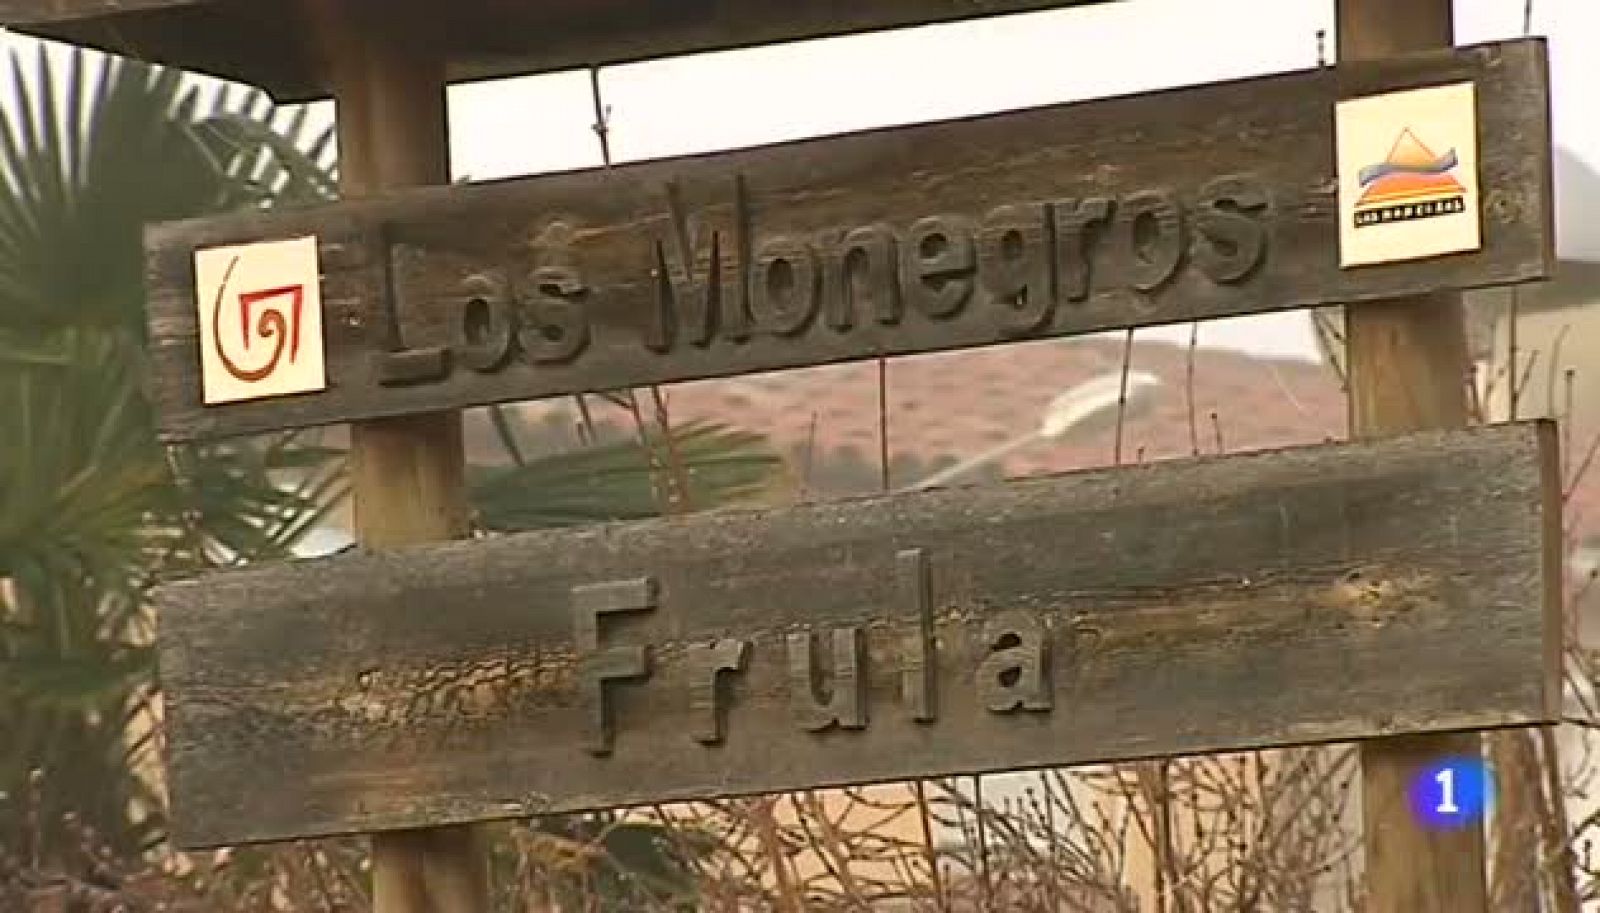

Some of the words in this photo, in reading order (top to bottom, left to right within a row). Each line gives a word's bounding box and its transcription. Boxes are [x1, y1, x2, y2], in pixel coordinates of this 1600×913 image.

[370, 218, 592, 388] Los
[640, 172, 1270, 355] Monegros
[571, 547, 1053, 759] Frula
